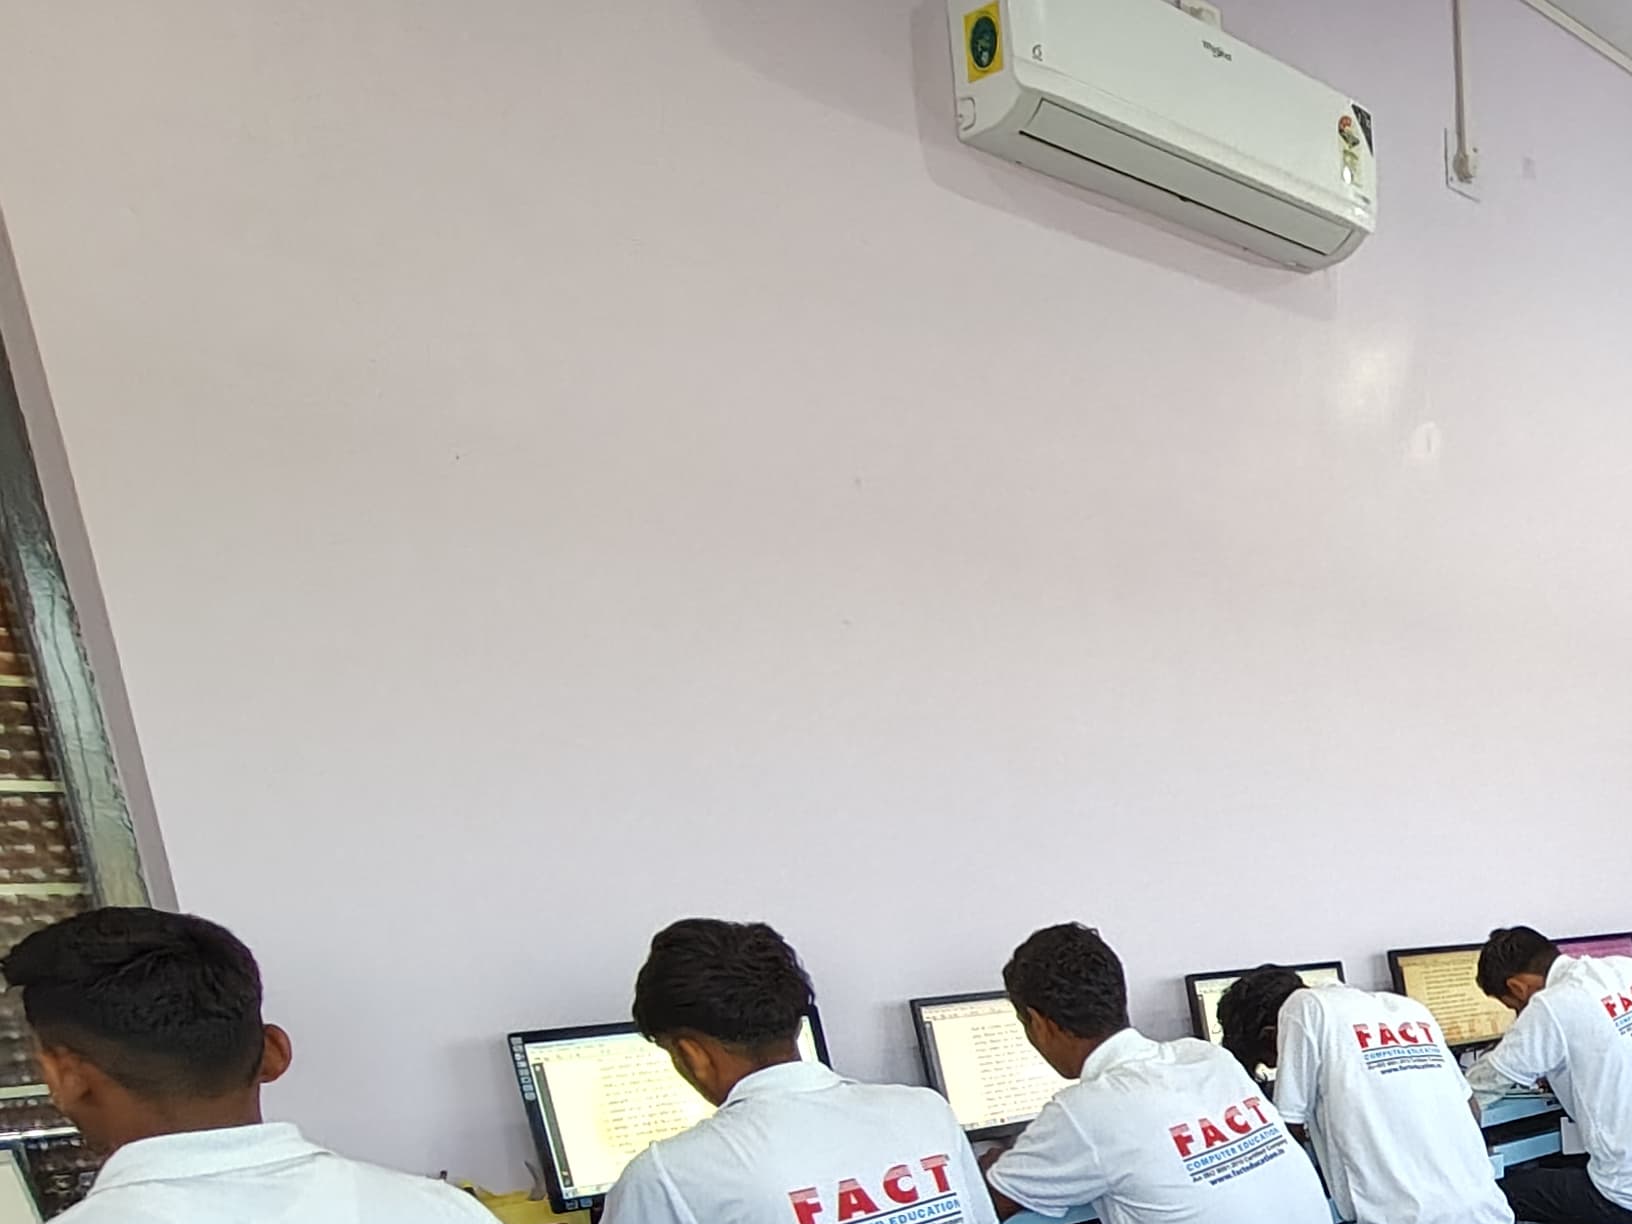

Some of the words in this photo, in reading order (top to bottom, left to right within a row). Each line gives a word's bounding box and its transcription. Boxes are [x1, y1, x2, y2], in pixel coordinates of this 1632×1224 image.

[1353, 1021, 1433, 1049] FACT
[1169, 1096, 1268, 1158] FACT
[1186, 1147, 1237, 1172] COMPUTER
